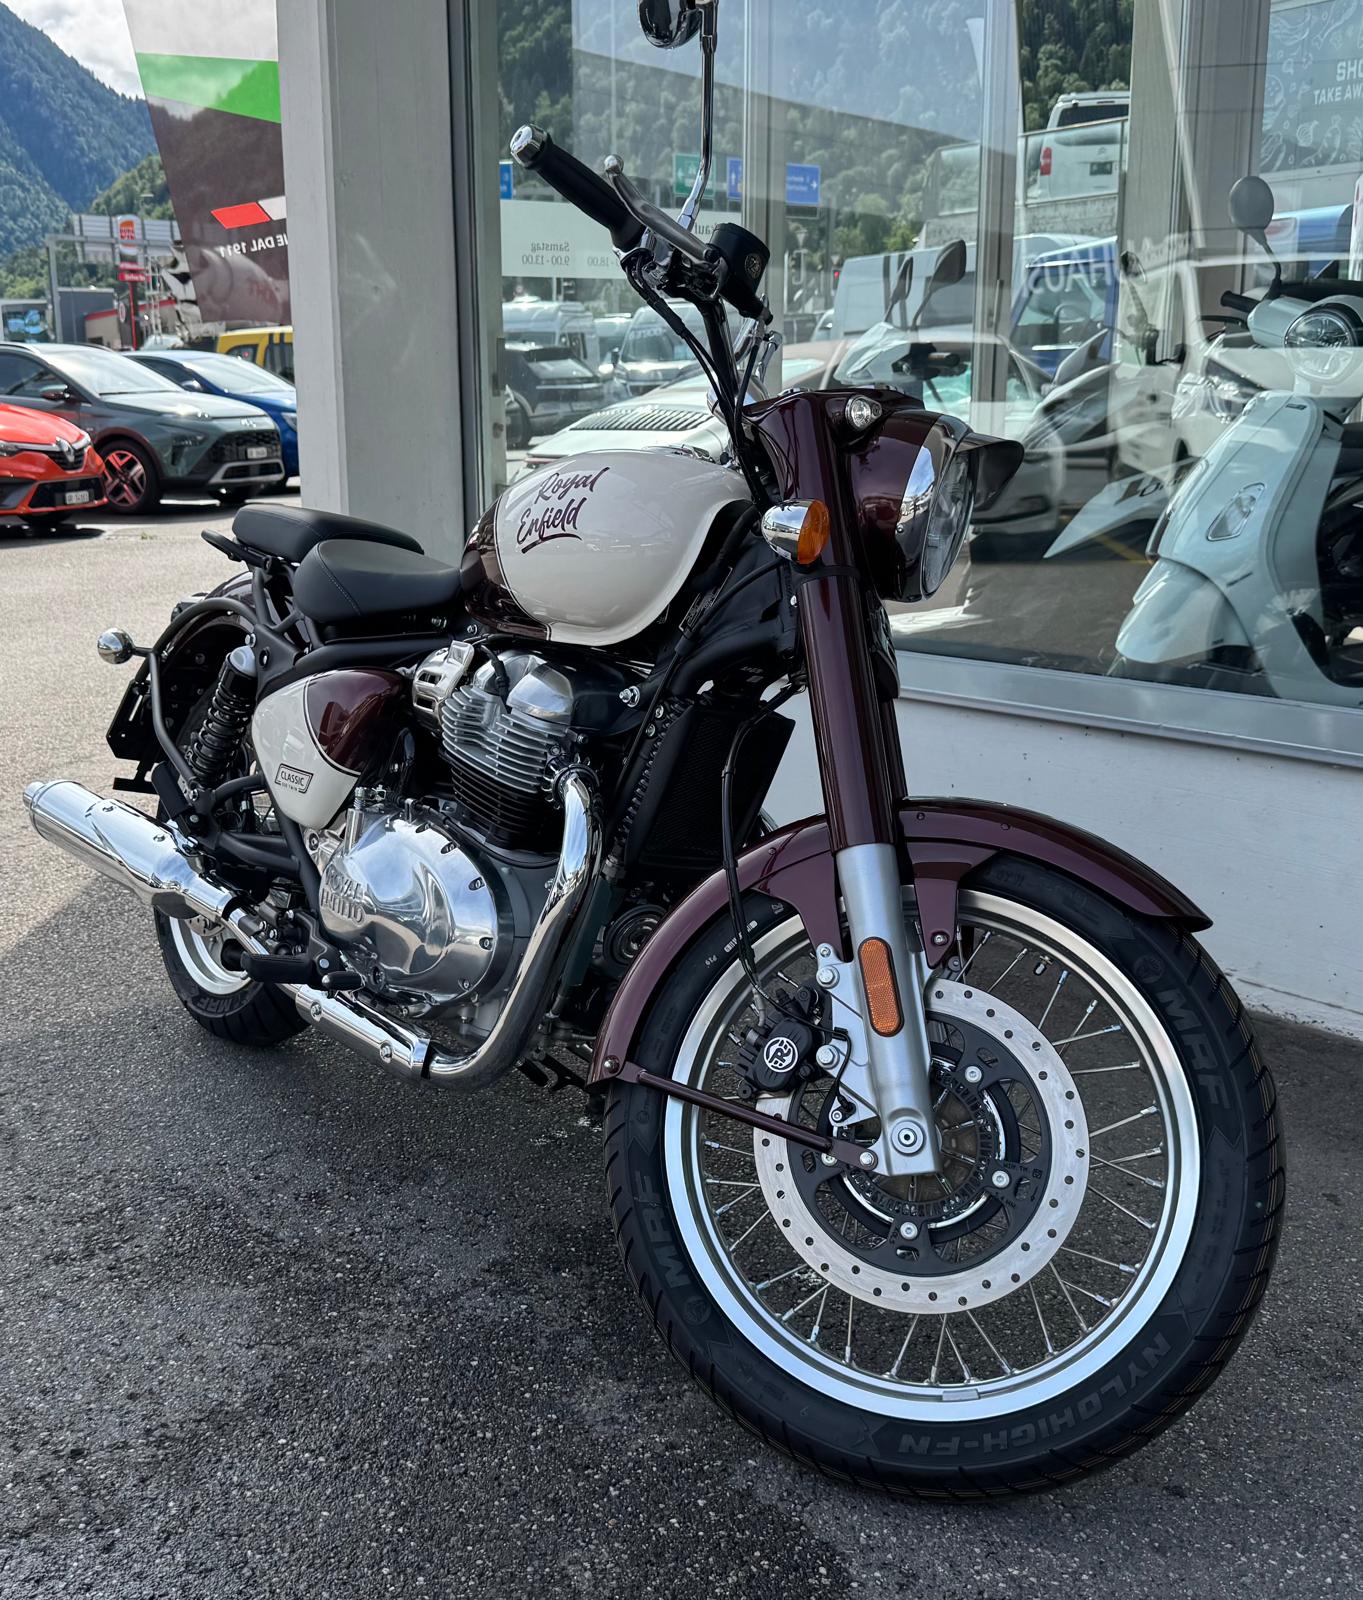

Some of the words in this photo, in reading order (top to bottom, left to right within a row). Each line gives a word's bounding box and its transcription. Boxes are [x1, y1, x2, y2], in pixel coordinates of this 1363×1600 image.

[1313, 86, 1342, 105] TAKE
[534, 466, 610, 505] Royal
[516, 497, 588, 548] Enfield
[280, 770, 305, 787] CLASSIC
[1155, 987, 1232, 1110] MRF
[634, 1169, 692, 1289] MRF
